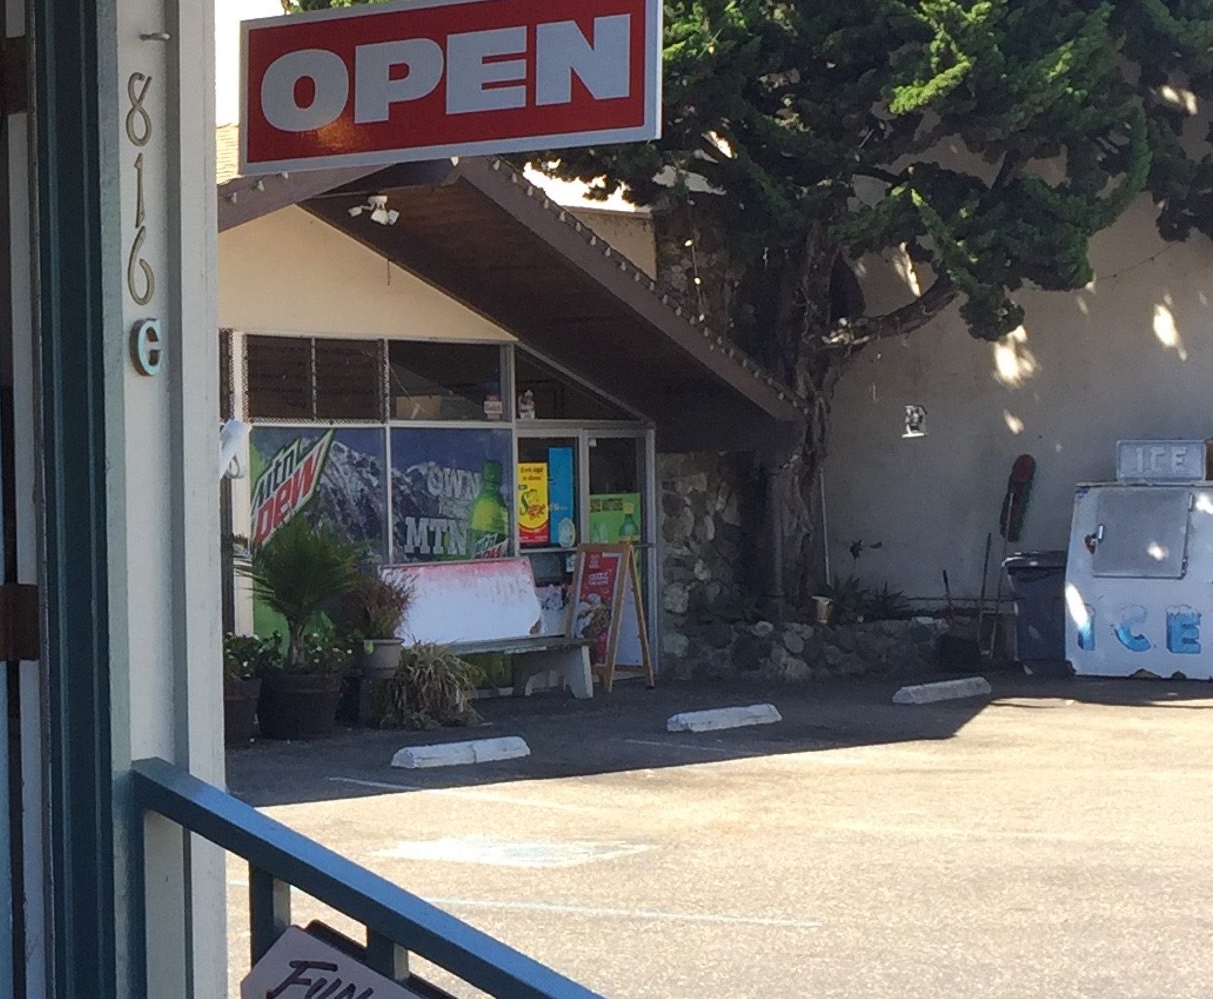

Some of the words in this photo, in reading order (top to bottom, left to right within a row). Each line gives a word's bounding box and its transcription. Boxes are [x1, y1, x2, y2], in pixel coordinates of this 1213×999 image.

[260, 13, 632, 133] OPEN
[1136, 446, 1187, 473] ICE
[427, 461, 484, 500] OWN
[403, 516, 471, 556] MTN
[1077, 603, 1202, 654] ICE
